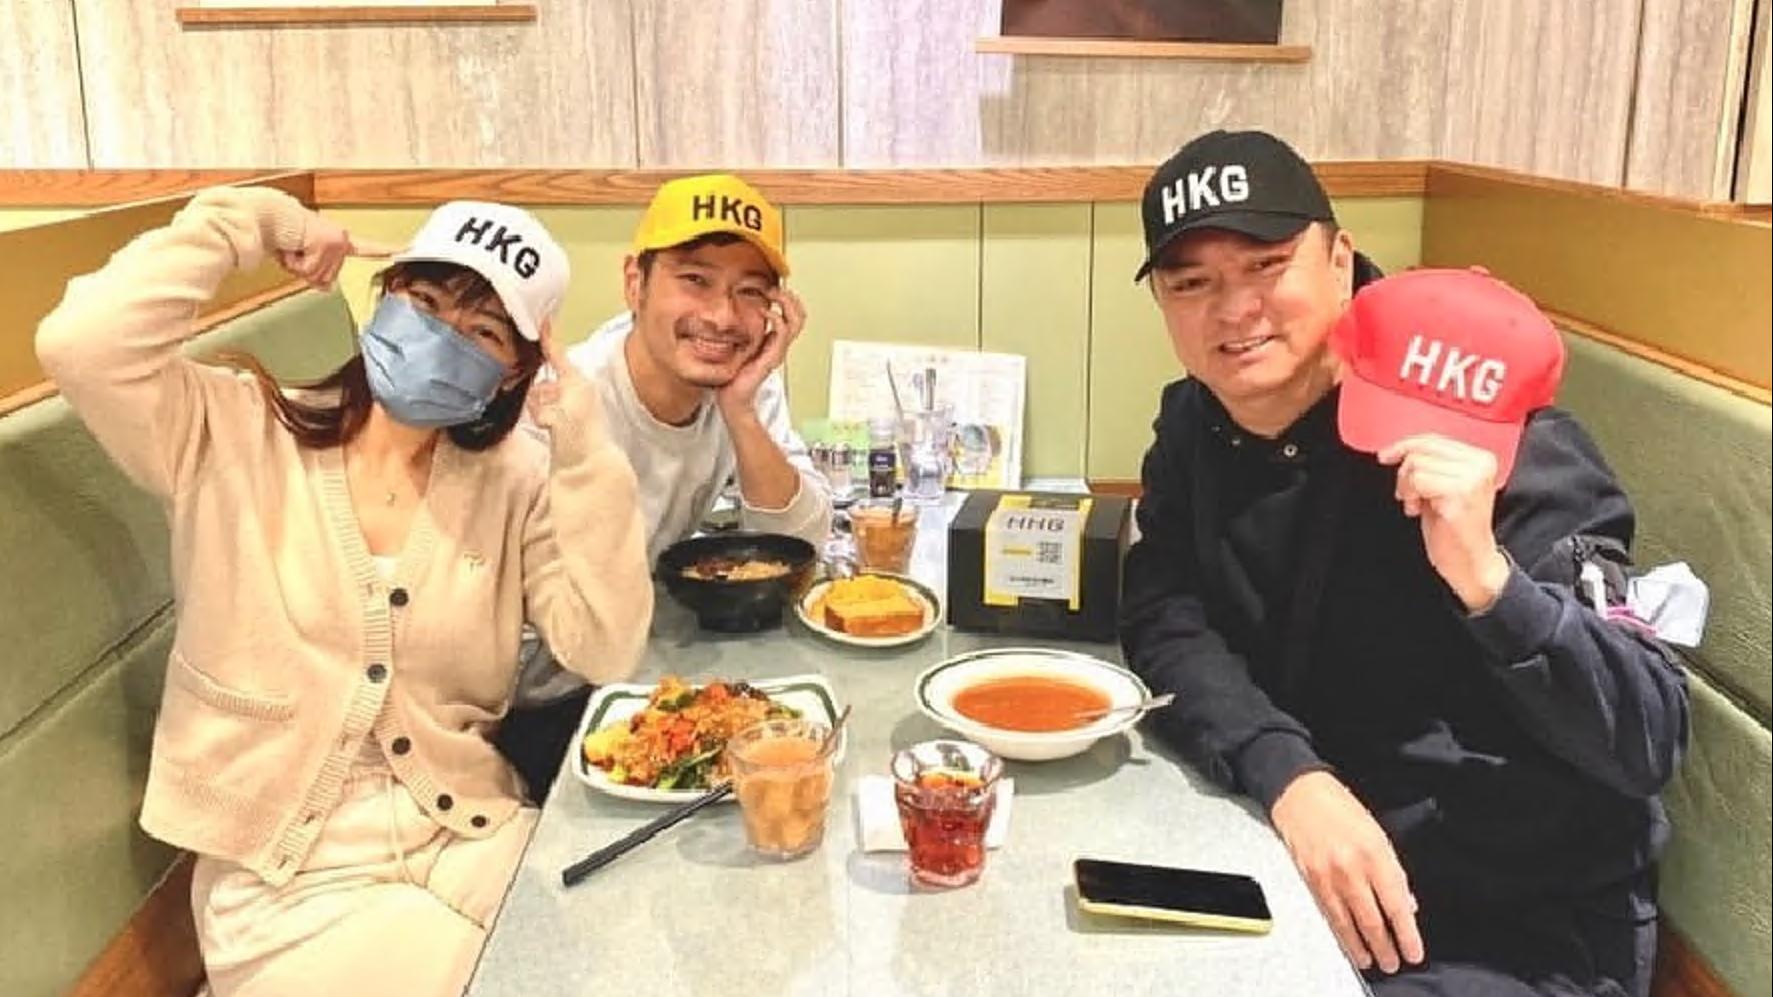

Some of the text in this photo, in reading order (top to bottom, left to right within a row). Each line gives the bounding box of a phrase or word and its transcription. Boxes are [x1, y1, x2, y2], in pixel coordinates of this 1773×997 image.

[693, 194, 762, 232] HKG
[1162, 165, 1249, 225] HKG
[455, 217, 540, 279] HKG
[1400, 335, 1506, 403] HKG
